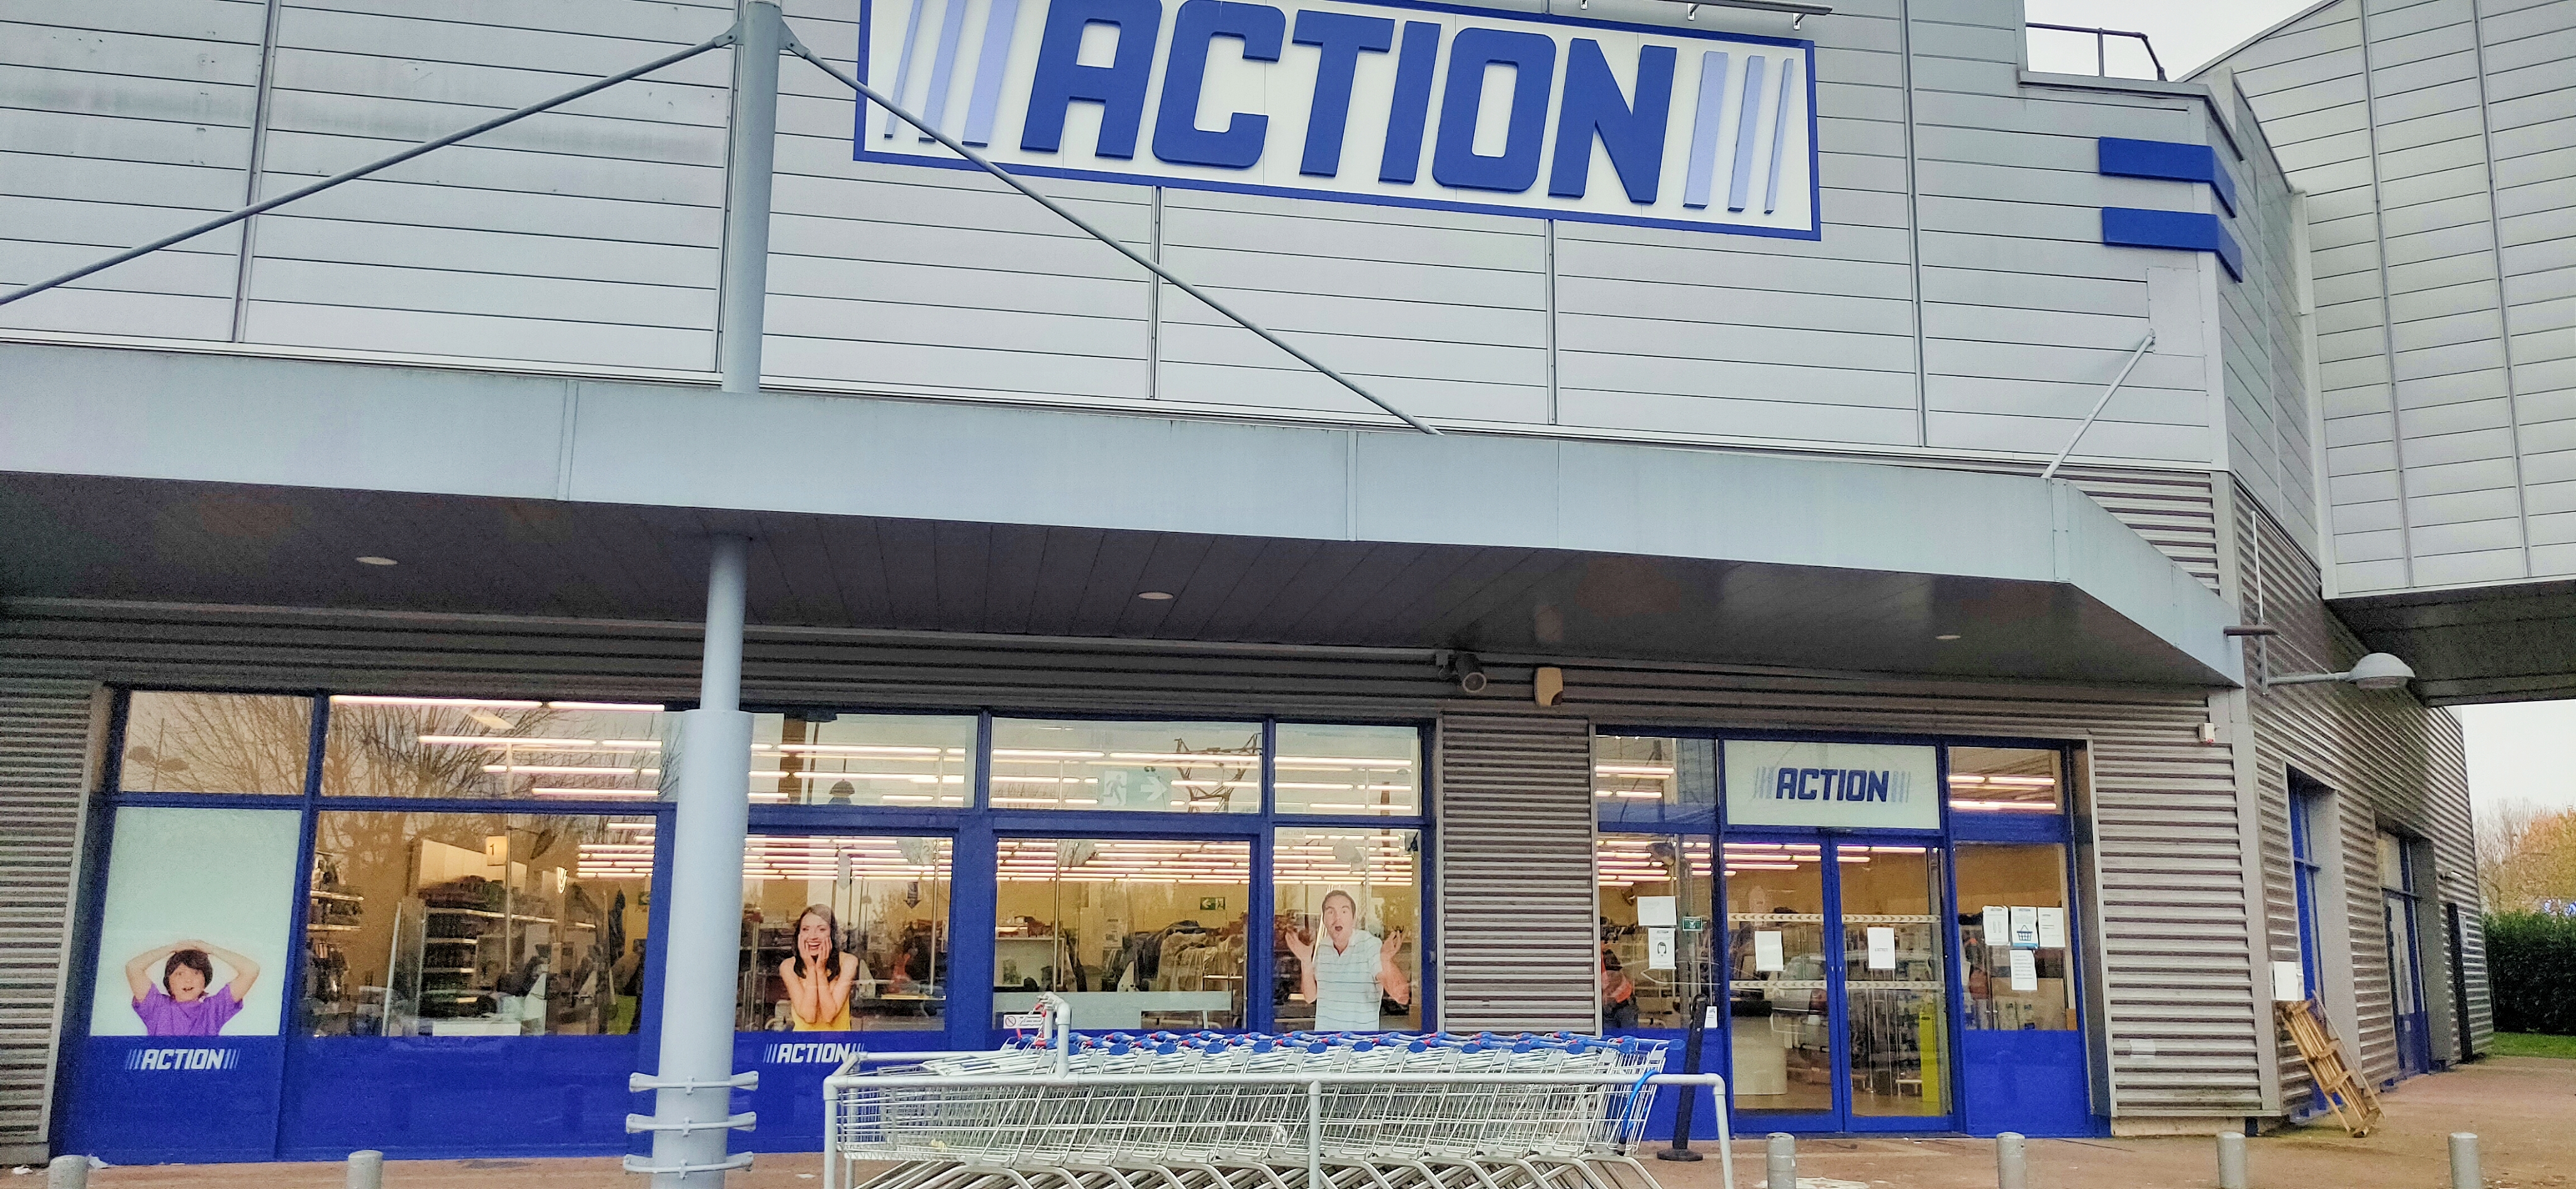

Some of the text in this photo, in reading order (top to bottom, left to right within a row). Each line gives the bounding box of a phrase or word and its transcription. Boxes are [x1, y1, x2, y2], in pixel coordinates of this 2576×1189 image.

[1019, 0, 1677, 204] ACTION
[1776, 768, 1889, 802] ACTION
[140, 1049, 225, 1070] ACTION
[777, 1043, 851, 1063] ACTION
